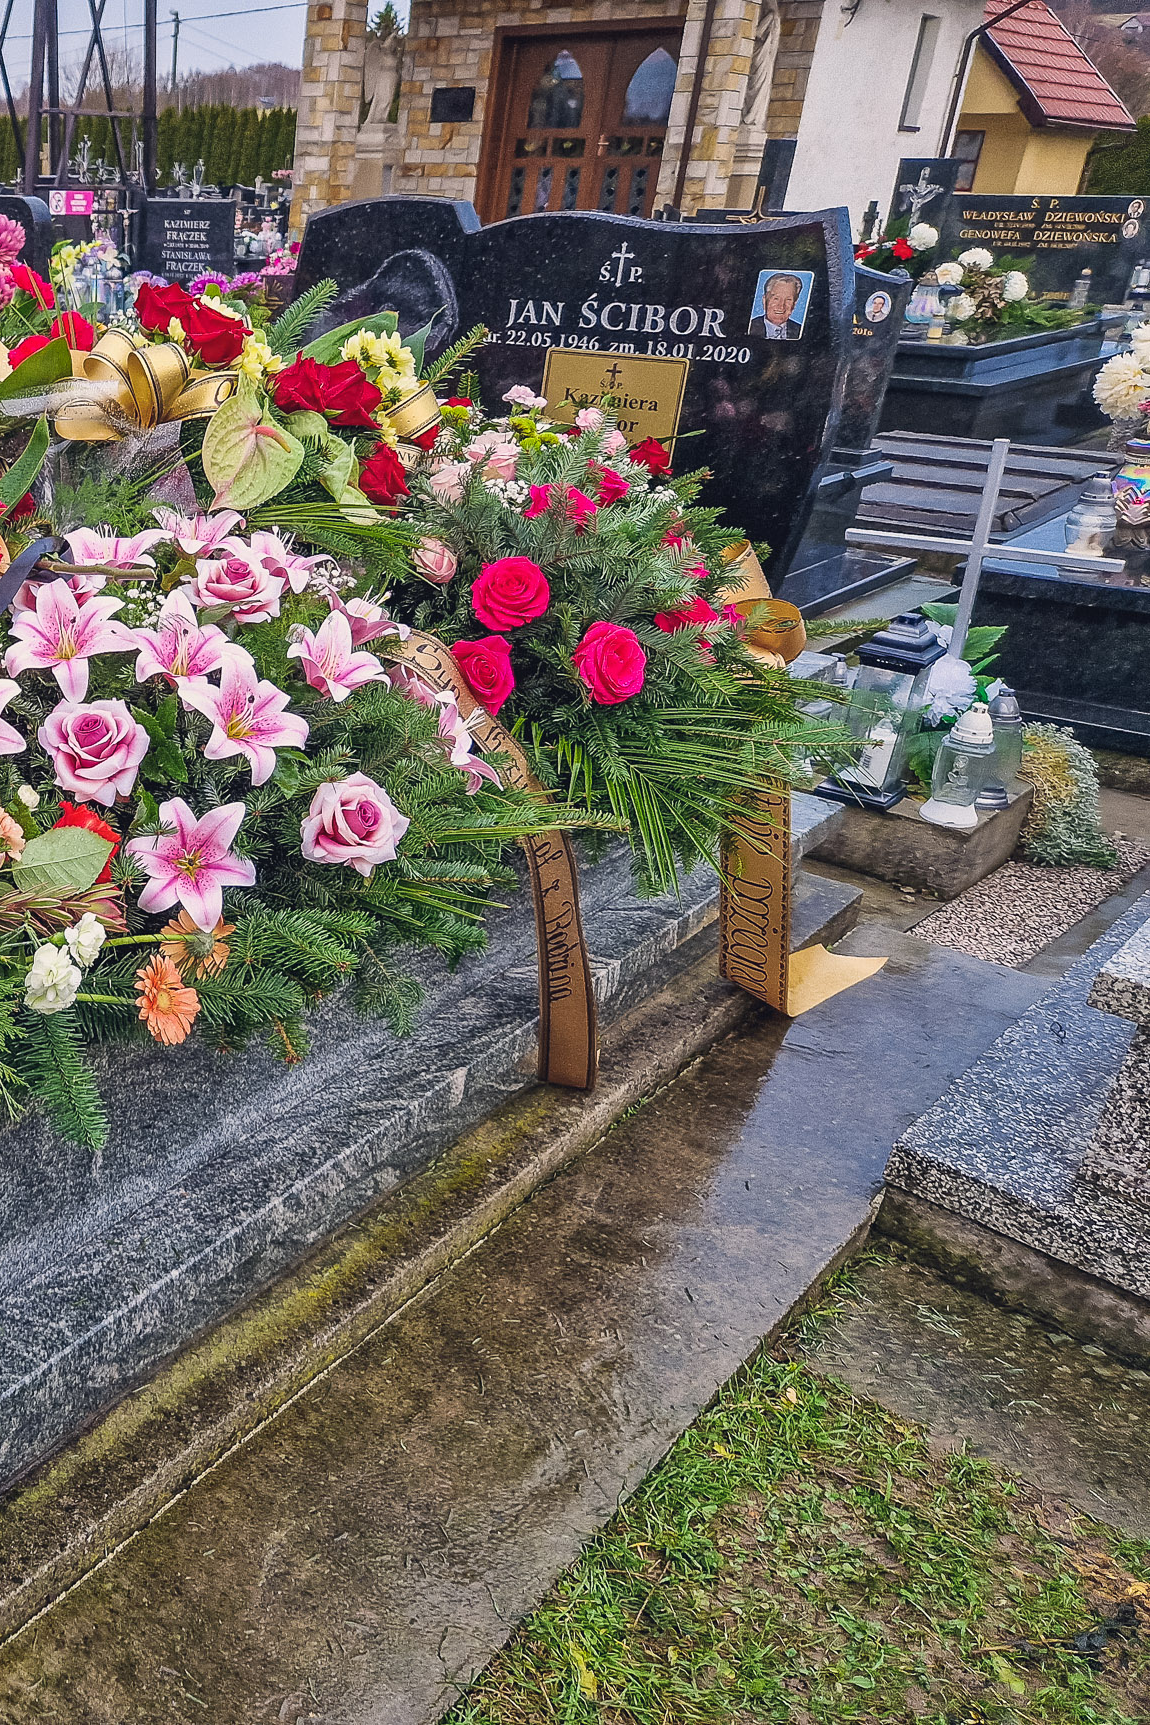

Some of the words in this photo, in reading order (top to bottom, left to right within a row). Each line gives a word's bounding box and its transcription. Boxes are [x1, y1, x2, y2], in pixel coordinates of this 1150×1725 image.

[962, 211, 1036, 221] WŁADYSŁAW
[1044, 211, 1125, 224] DZIEWOŃSKI
[164, 220, 210, 229] KAZIMIERZ
[167, 231, 207, 242] FRĄCZEK
[959, 230, 1021, 240] GENOWEFA
[1033, 230, 1118, 243] DZIEWOŃSKA
[166, 261, 204, 272] FRĄCZEK
[600, 261, 616, 282] Ś.
[629, 266, 644, 283] P.
[505, 299, 565, 328] JAN
[578, 293, 726, 338] ŚCIBOR
[505, 330, 599, 351] 22.05.1946
[608, 342, 640, 355] zm.
[646, 341, 750, 364] 18.01.2020
[724, 869, 779, 1002] pożegna
